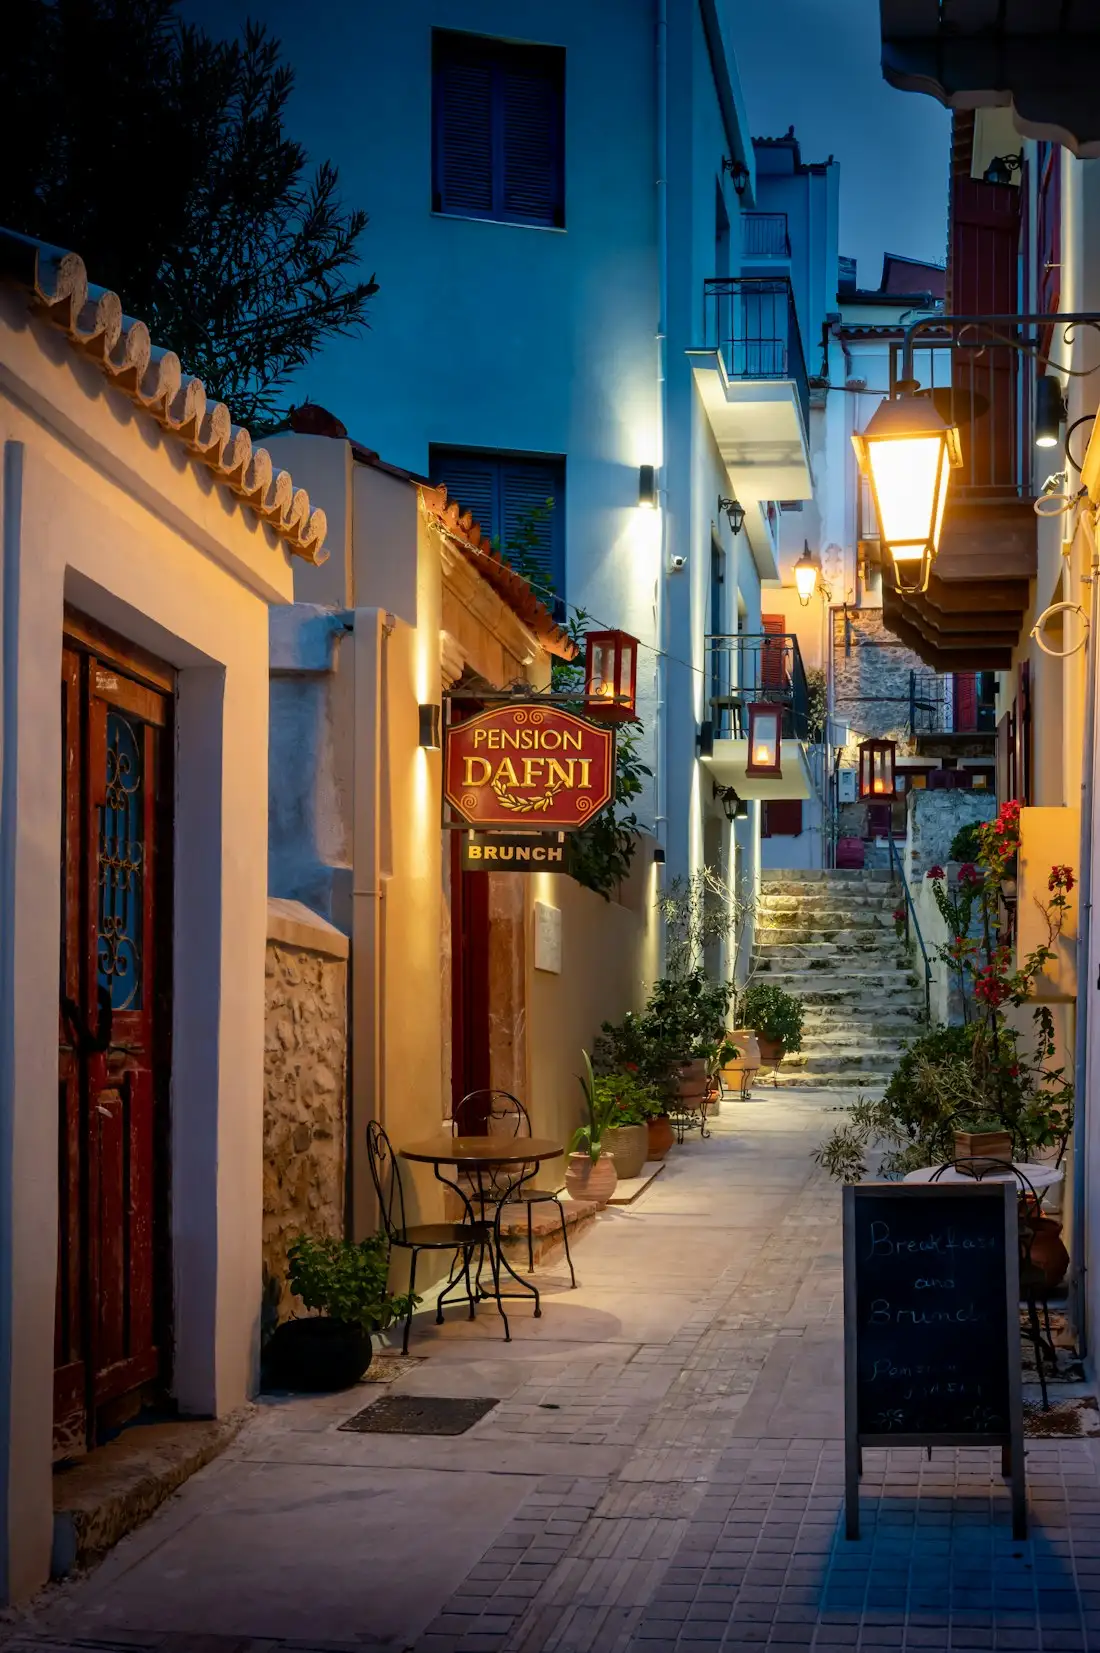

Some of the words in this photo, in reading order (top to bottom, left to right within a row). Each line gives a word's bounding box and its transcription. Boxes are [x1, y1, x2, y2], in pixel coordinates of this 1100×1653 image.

[473, 729, 582, 750] PENSION
[462, 756, 593, 789] DAFNI
[468, 845, 563, 861] BRUNCH
